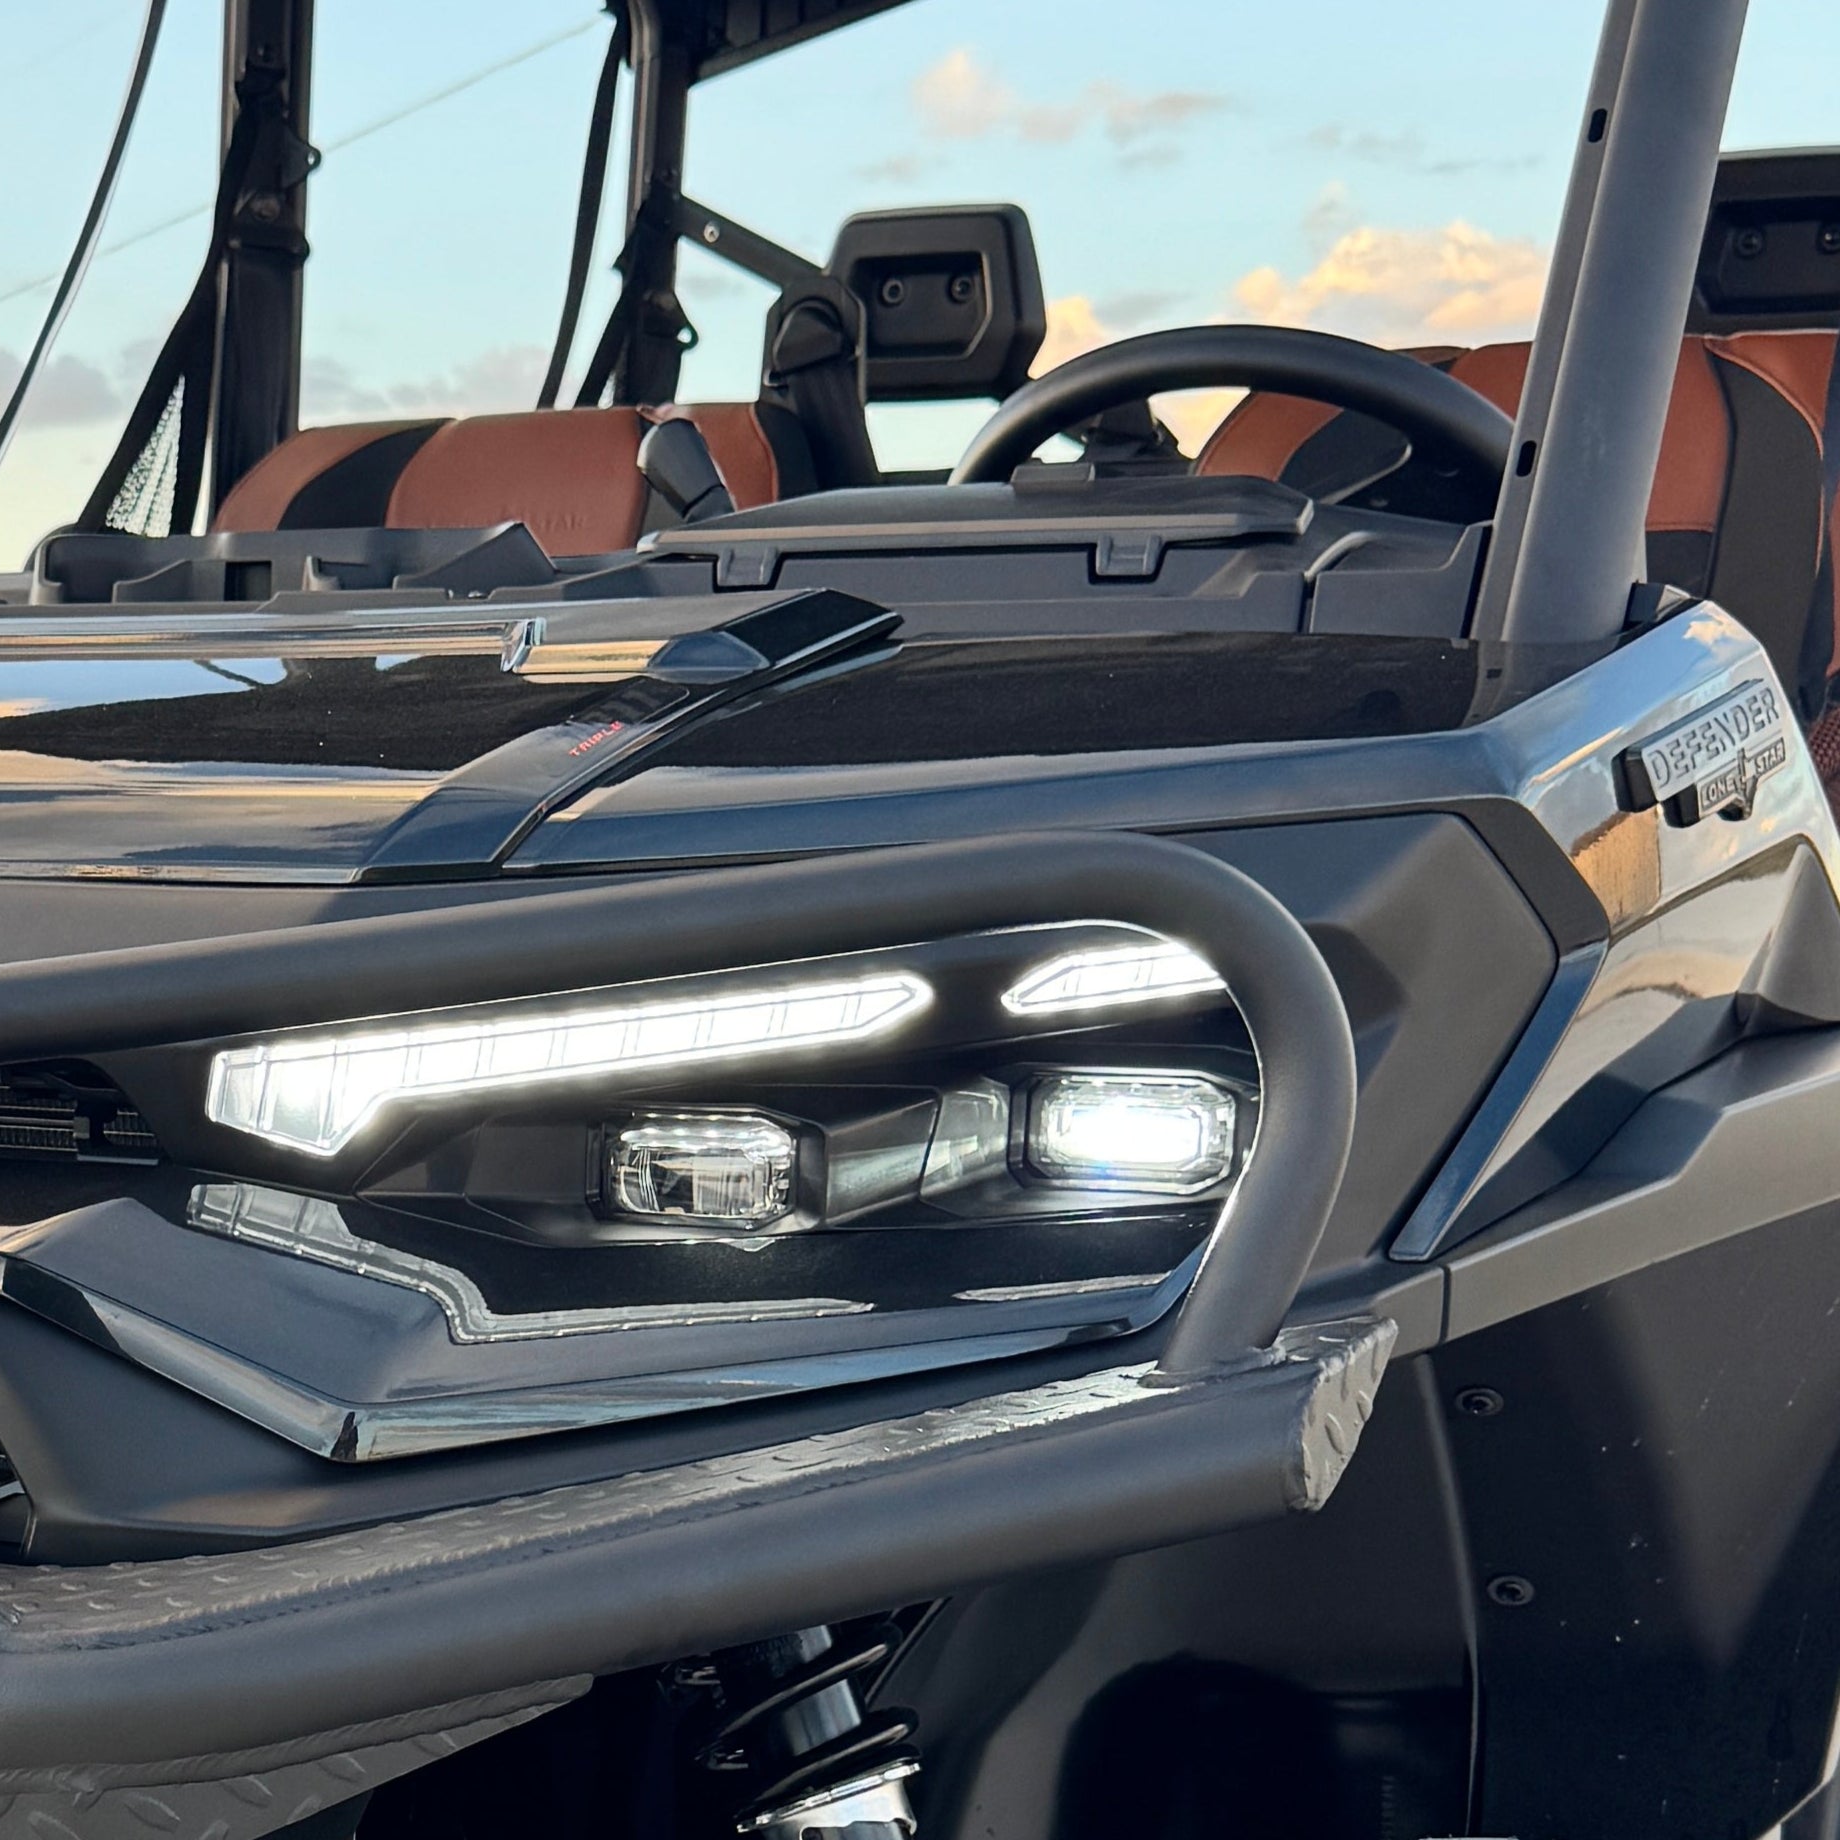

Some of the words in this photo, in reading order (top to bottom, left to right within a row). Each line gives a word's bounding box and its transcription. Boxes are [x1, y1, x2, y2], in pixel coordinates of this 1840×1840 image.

[1647, 687, 1780, 790] DEFENDER
[1700, 773, 1738, 805] LONE
[1753, 743, 1786, 776] STAR
